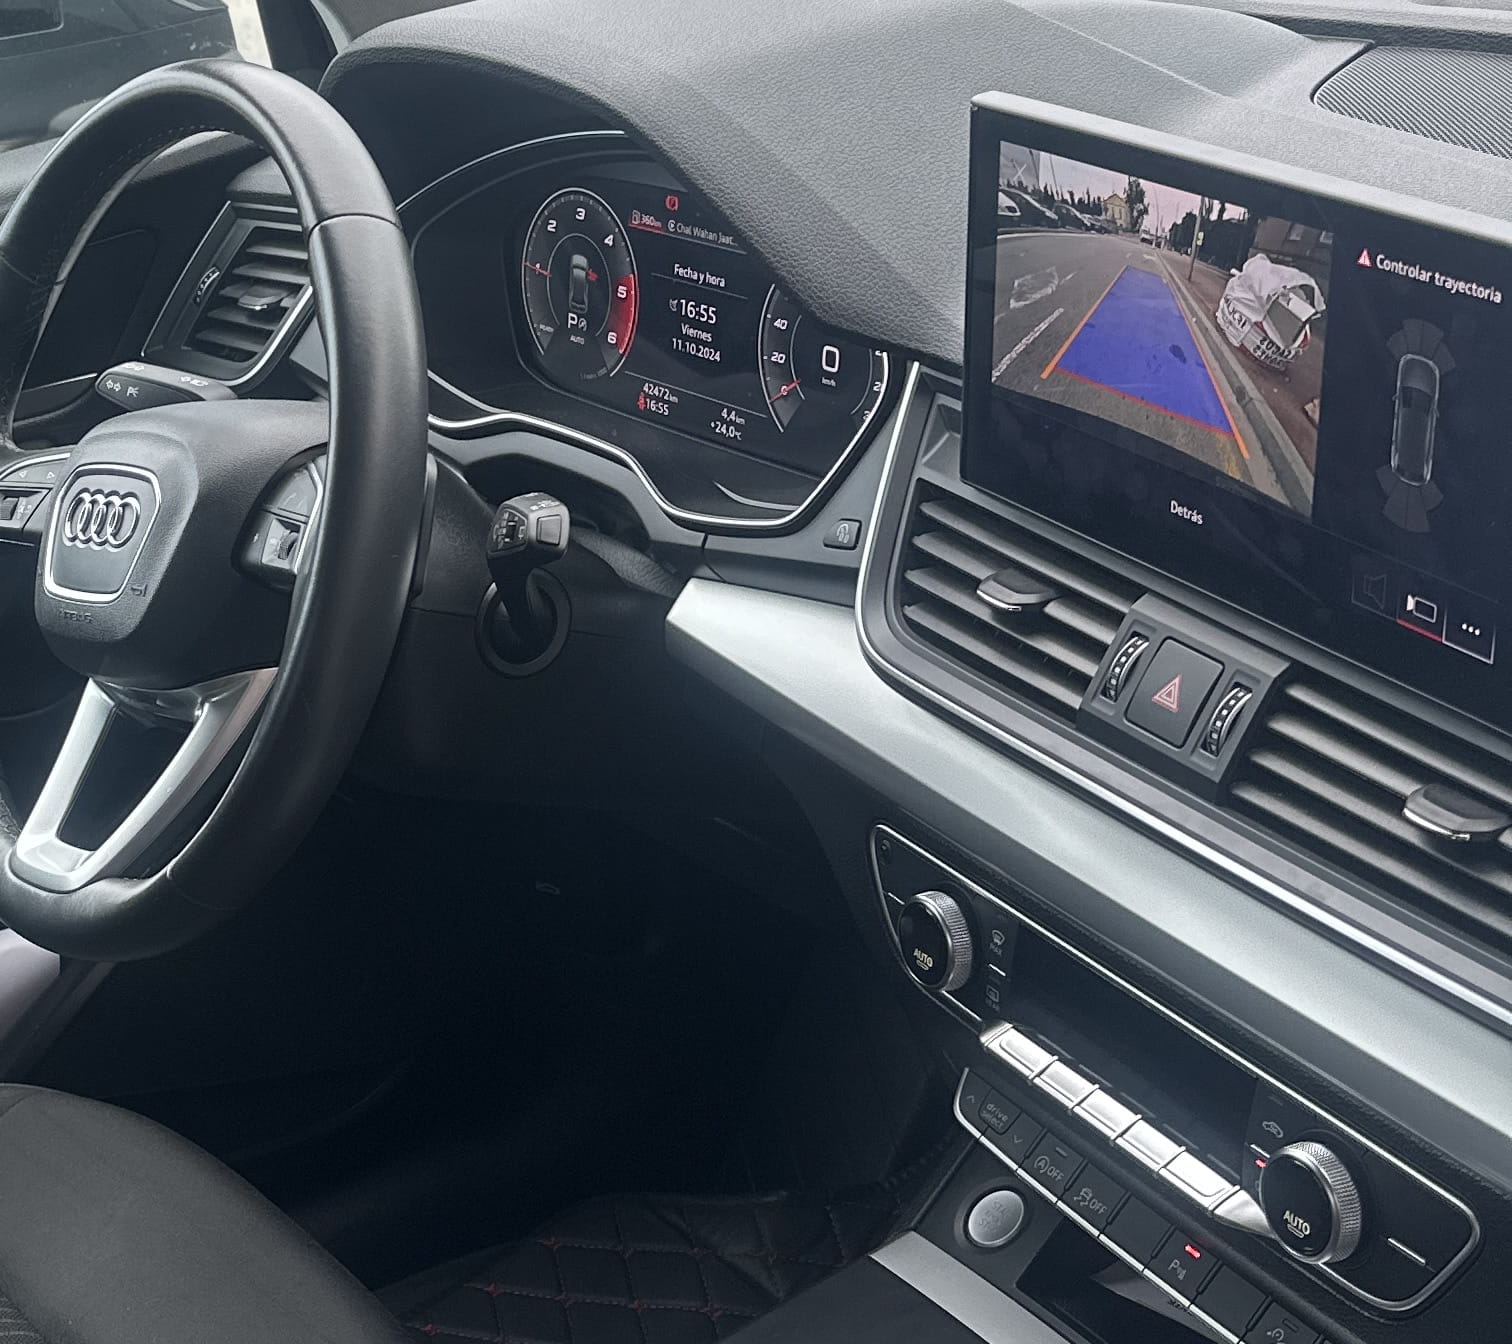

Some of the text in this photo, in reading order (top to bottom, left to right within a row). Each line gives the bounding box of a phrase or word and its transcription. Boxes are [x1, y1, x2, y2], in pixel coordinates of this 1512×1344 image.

[575, 207, 585, 220] 3
[547, 219, 557, 232] 2
[604, 234, 614, 247] 4
[674, 264, 726, 287] Fecha y hora
[1376, 254, 1502, 304] Controlar trayectoria
[617, 286, 627, 299] 5
[679, 299, 717, 324] 16:55
[568, 313, 578, 328] P
[774, 318, 788, 330] 40
[570, 335, 585, 345] AUTO
[607, 331, 617, 344] 6
[681, 323, 712, 342] Viernes
[672, 338, 721, 362] 11.10.2024
[771, 352, 785, 364] 20
[822, 345, 839, 373] 0
[646, 398, 669, 416] 16:55
[1170, 499, 1203, 525] Detrás
[913, 948, 933, 967] AUTO
[986, 1103, 1008, 1122] drive
[1046, 1167, 1065, 1182] OFF
[1089, 1199, 1108, 1214] OFF
[1283, 1210, 1310, 1235] AUTO
